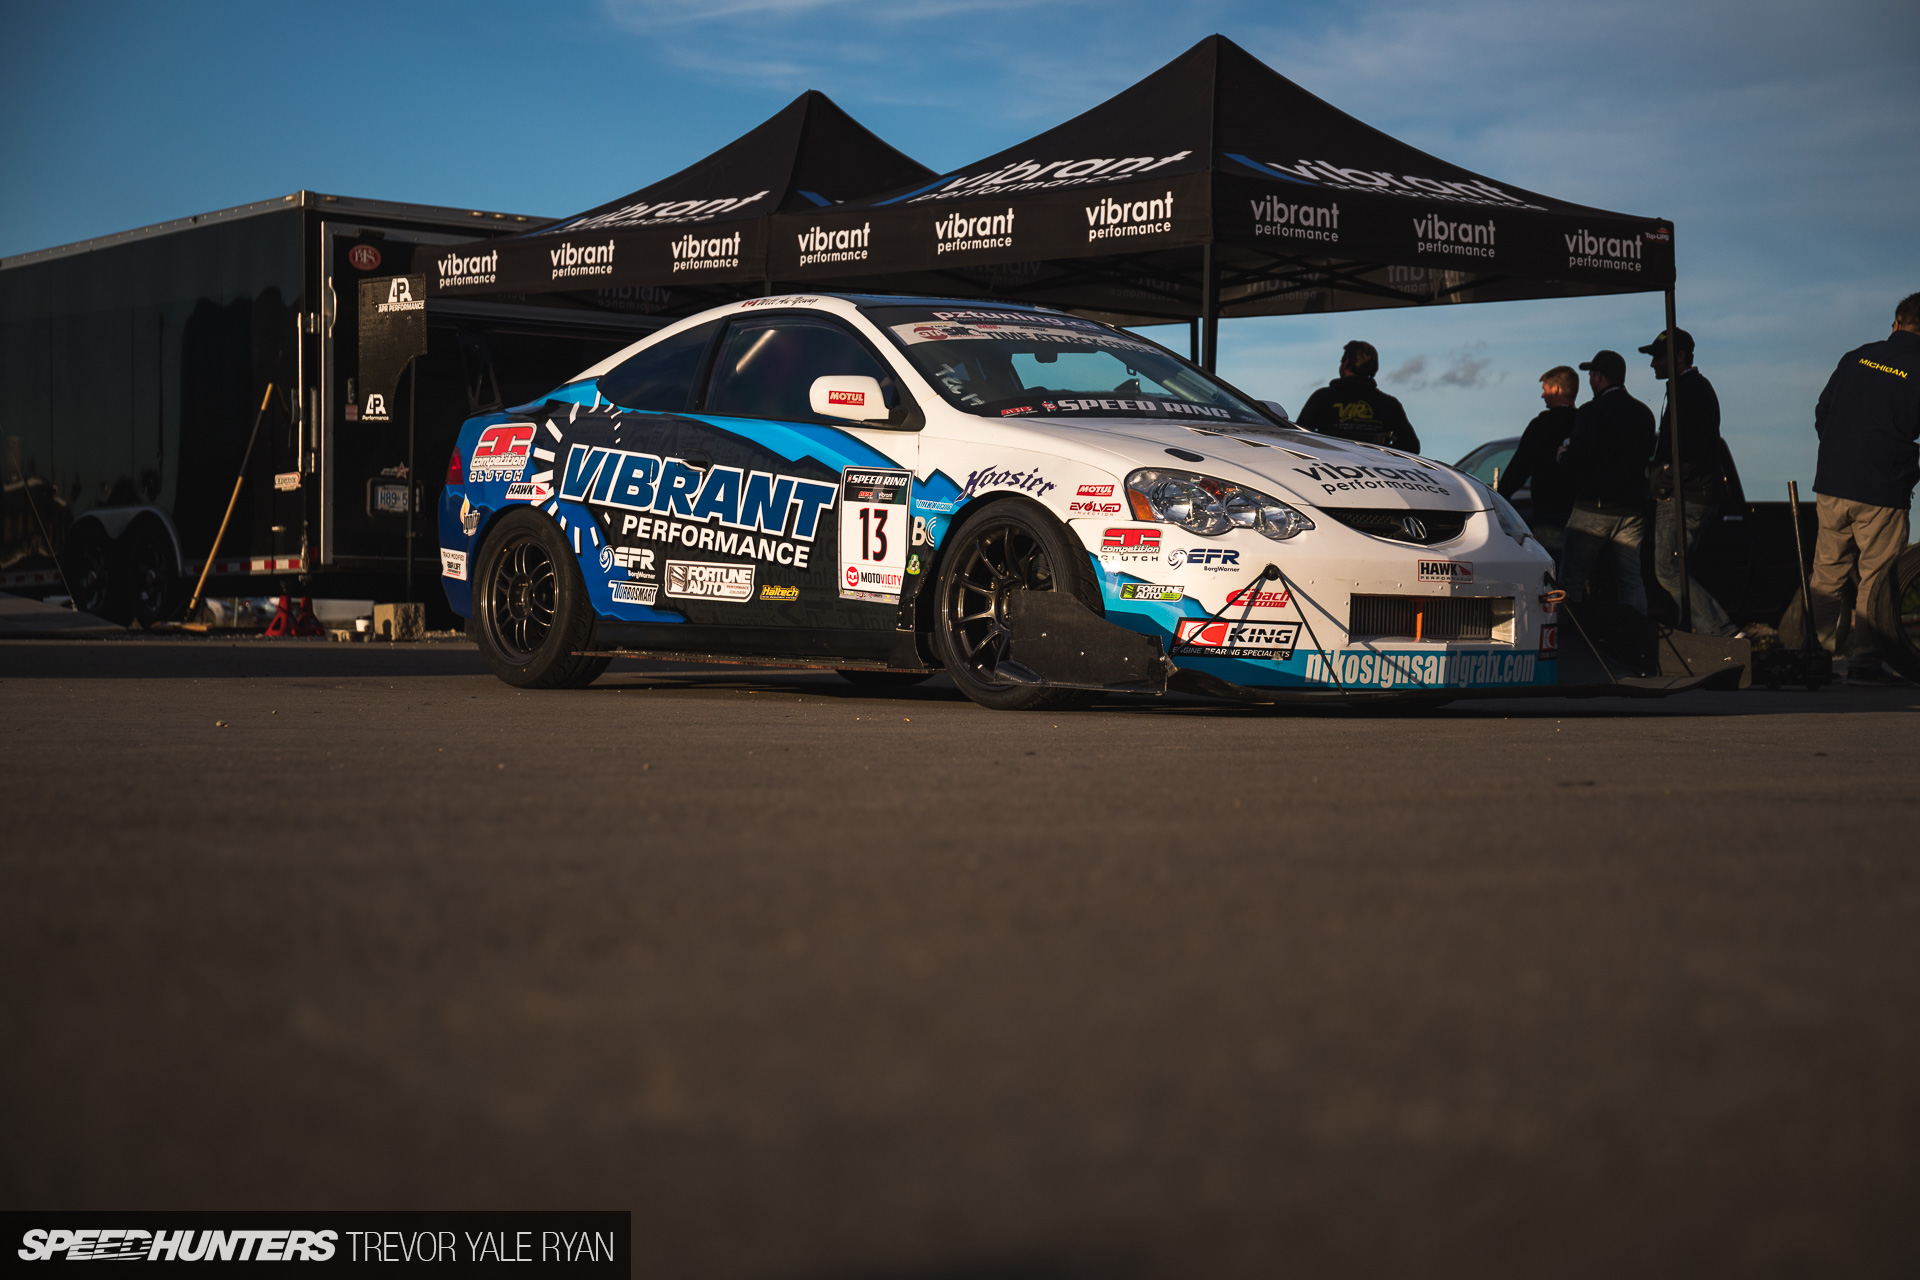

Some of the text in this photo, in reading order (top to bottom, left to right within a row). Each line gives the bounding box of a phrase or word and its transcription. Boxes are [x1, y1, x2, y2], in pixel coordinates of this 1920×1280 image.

[941, 150, 1193, 193] vibrant
[1264, 158, 1526, 204] vibrant
[566, 189, 770, 230] vibrant
[1085, 191, 1173, 227] vibrant
[1250, 195, 1339, 229] vibrant
[935, 207, 1014, 240] vibrant
[1088, 220, 1172, 242] performance
[1254, 223, 1339, 242] performance
[1413, 213, 1496, 246] vibrant
[671, 231, 741, 259] vibrant
[797, 221, 870, 253] vibrant
[937, 237, 1012, 255] performance
[1564, 229, 1643, 260] vibrant
[550, 239, 615, 267] vibrant
[799, 248, 868, 267] performance
[1417, 240, 1495, 258] performance
[437, 249, 498, 278] vibrant
[552, 264, 613, 280] performance
[673, 255, 739, 273] performance
[1568, 255, 1642, 273] performance
[439, 273, 496, 289] performance
[389, 302, 424, 312] PERFORMANCE
[981, 331, 1031, 341] TIME
[1032, 332, 1102, 347] ATTACK
[1858, 358, 1908, 379] MICHIGAN
[829, 391, 864, 402] MOTUL
[361, 414, 390, 422] Performance
[1057, 399, 1231, 419] SPEED RING
[472, 452, 526, 468] competition
[469, 470, 524, 483] CLUTCH
[851, 474, 907, 487] SPEED RING
[1294, 462, 1439, 485] vibrant
[508, 485, 535, 495] HAWK
[559, 443, 840, 543] VIBRANT
[954, 464, 1055, 504] Hoosier
[1079, 486, 1114, 494] MOTUL
[1321, 480, 1451, 496] performance
[1069, 500, 1122, 513] EVOLVED
[622, 514, 811, 569] PERFORMANCE
[859, 508, 888, 562] 13
[614, 546, 655, 570] EFR
[1101, 543, 1160, 556] competition
[1187, 548, 1239, 565] EFR
[628, 569, 656, 580] BorgWarner
[688, 566, 751, 584] FORTUNE
[1203, 565, 1240, 573] BorgWarner
[1420, 562, 1458, 576] HAWK
[688, 580, 724, 596] AUTO
[860, 572, 901, 586] MOTOVICITY
[609, 581, 657, 603] TURBOSMART
[762, 585, 799, 597] Haltech
[1136, 592, 1162, 600] AUTO
[1137, 585, 1184, 594] FORTUNE
[1228, 628, 1293, 644] KING
[1205, 647, 1240, 656] BEARING
[1242, 649, 1291, 658] SPECIALISTS
[1304, 649, 1536, 688] nikosignsandgrafx.com
